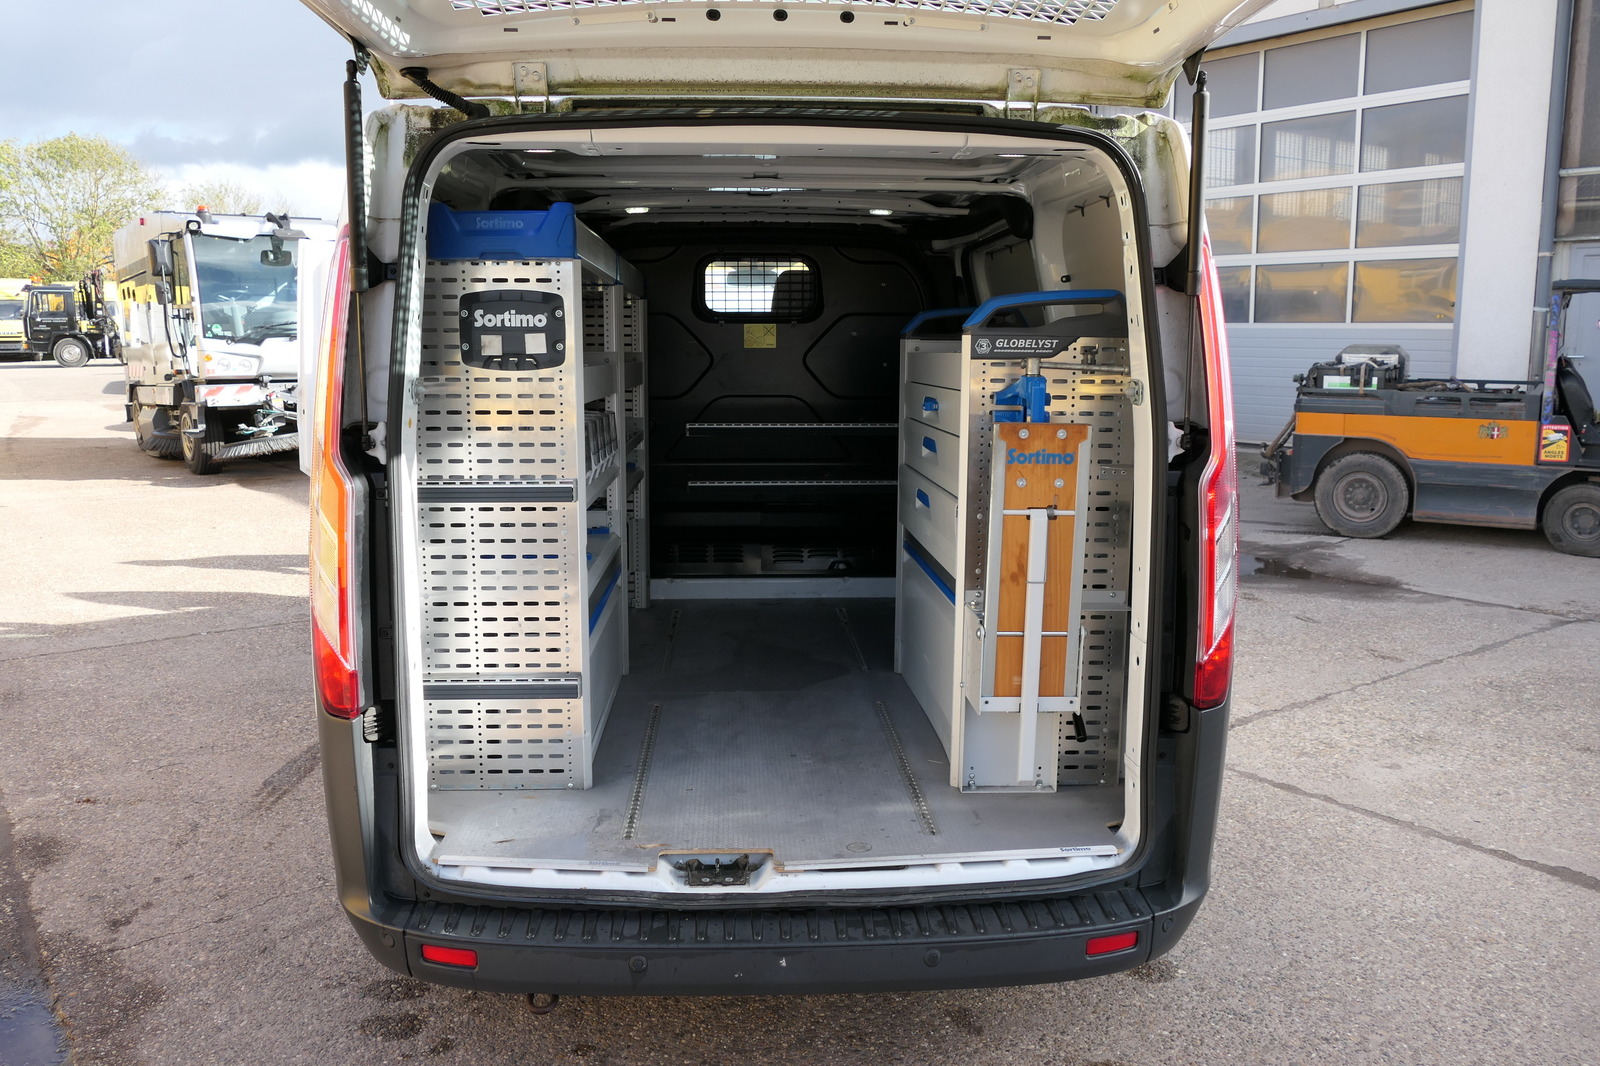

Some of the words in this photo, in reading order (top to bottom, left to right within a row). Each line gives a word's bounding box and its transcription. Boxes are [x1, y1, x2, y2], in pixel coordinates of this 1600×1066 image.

[475, 217, 524, 230] Sortimo
[474, 309, 548, 328] Sortimo
[995, 338, 1059, 348] GLOBELYST
[1006, 448, 1075, 465] Sortimo
